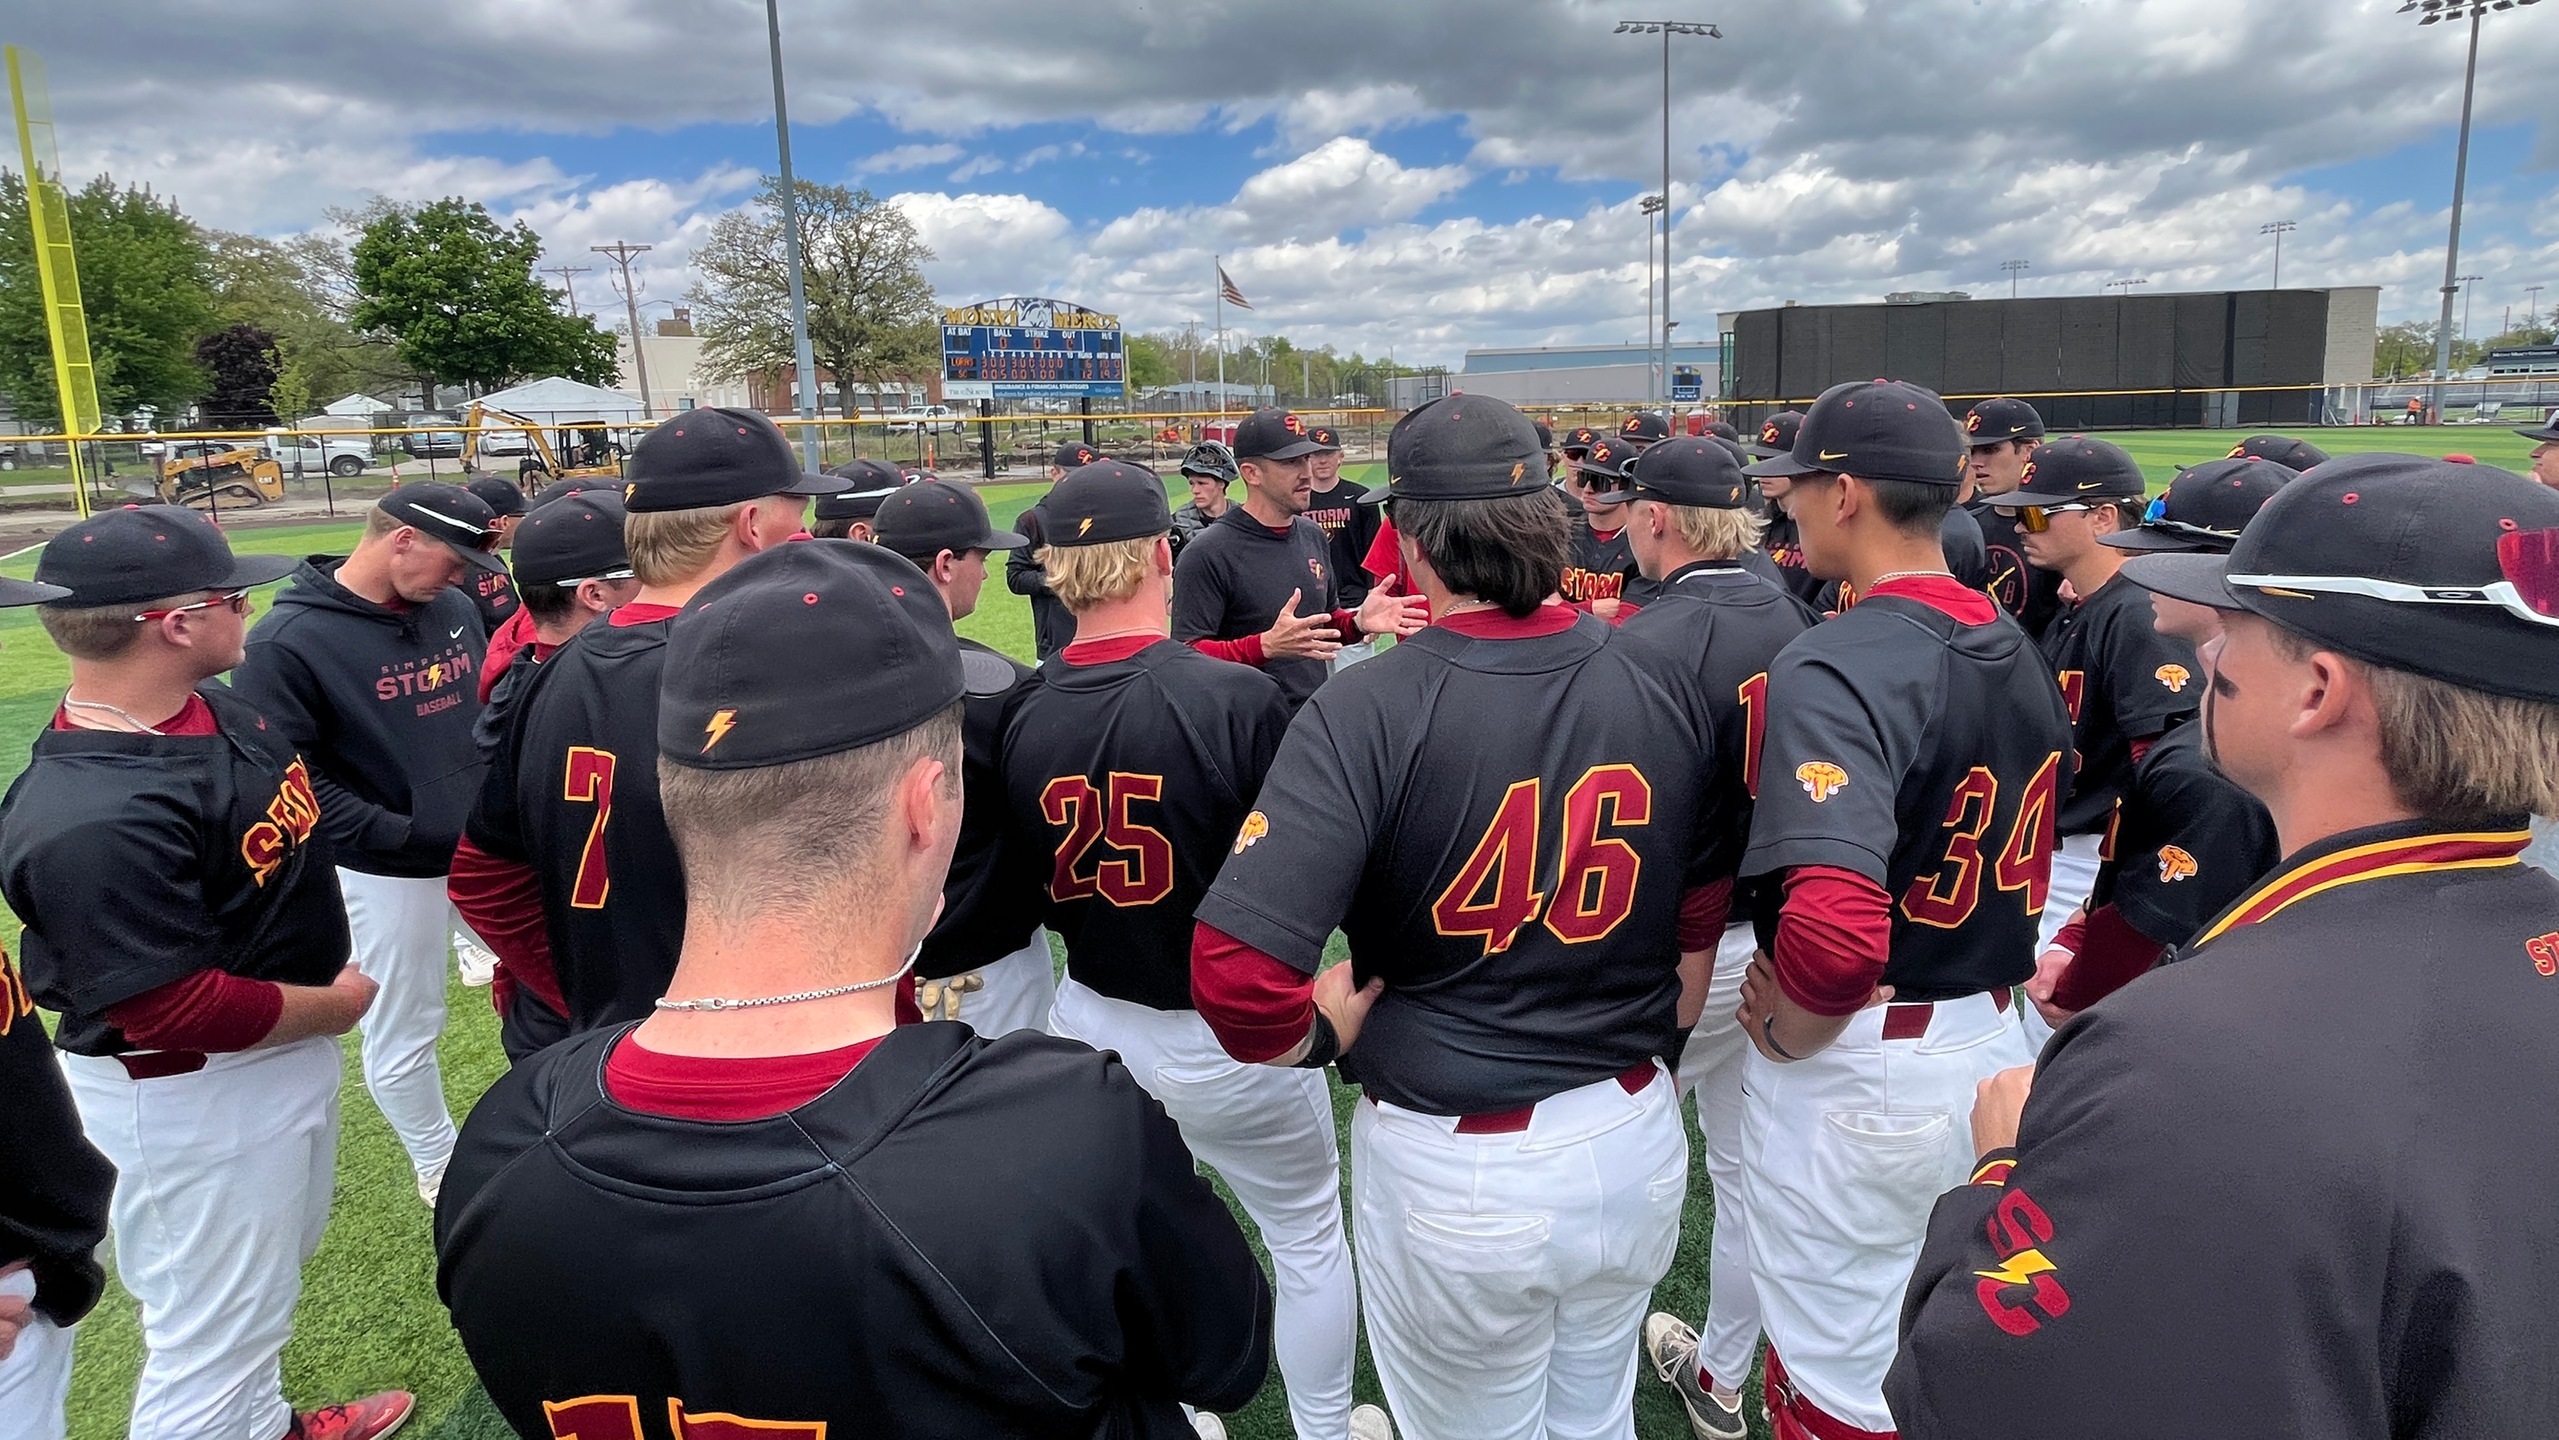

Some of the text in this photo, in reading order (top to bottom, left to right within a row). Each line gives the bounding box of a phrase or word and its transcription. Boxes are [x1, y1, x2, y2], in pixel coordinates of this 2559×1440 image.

[946, 307, 1119, 330] MOUNT MERCY
[947, 327, 972, 336] AT BAT
[993, 328, 1012, 337] BALL
[1024, 330, 1049, 338] STRIKE
[1062, 330, 1076, 339] OUT
[381, 643, 464, 674] SIMPSON
[375, 652, 472, 700] STORM
[416, 691, 462, 717] BASEBALL
[564, 746, 616, 909] 7
[1039, 771, 1174, 907] 25
[1900, 751, 2062, 929] 34
[1432, 763, 1651, 955] 46
